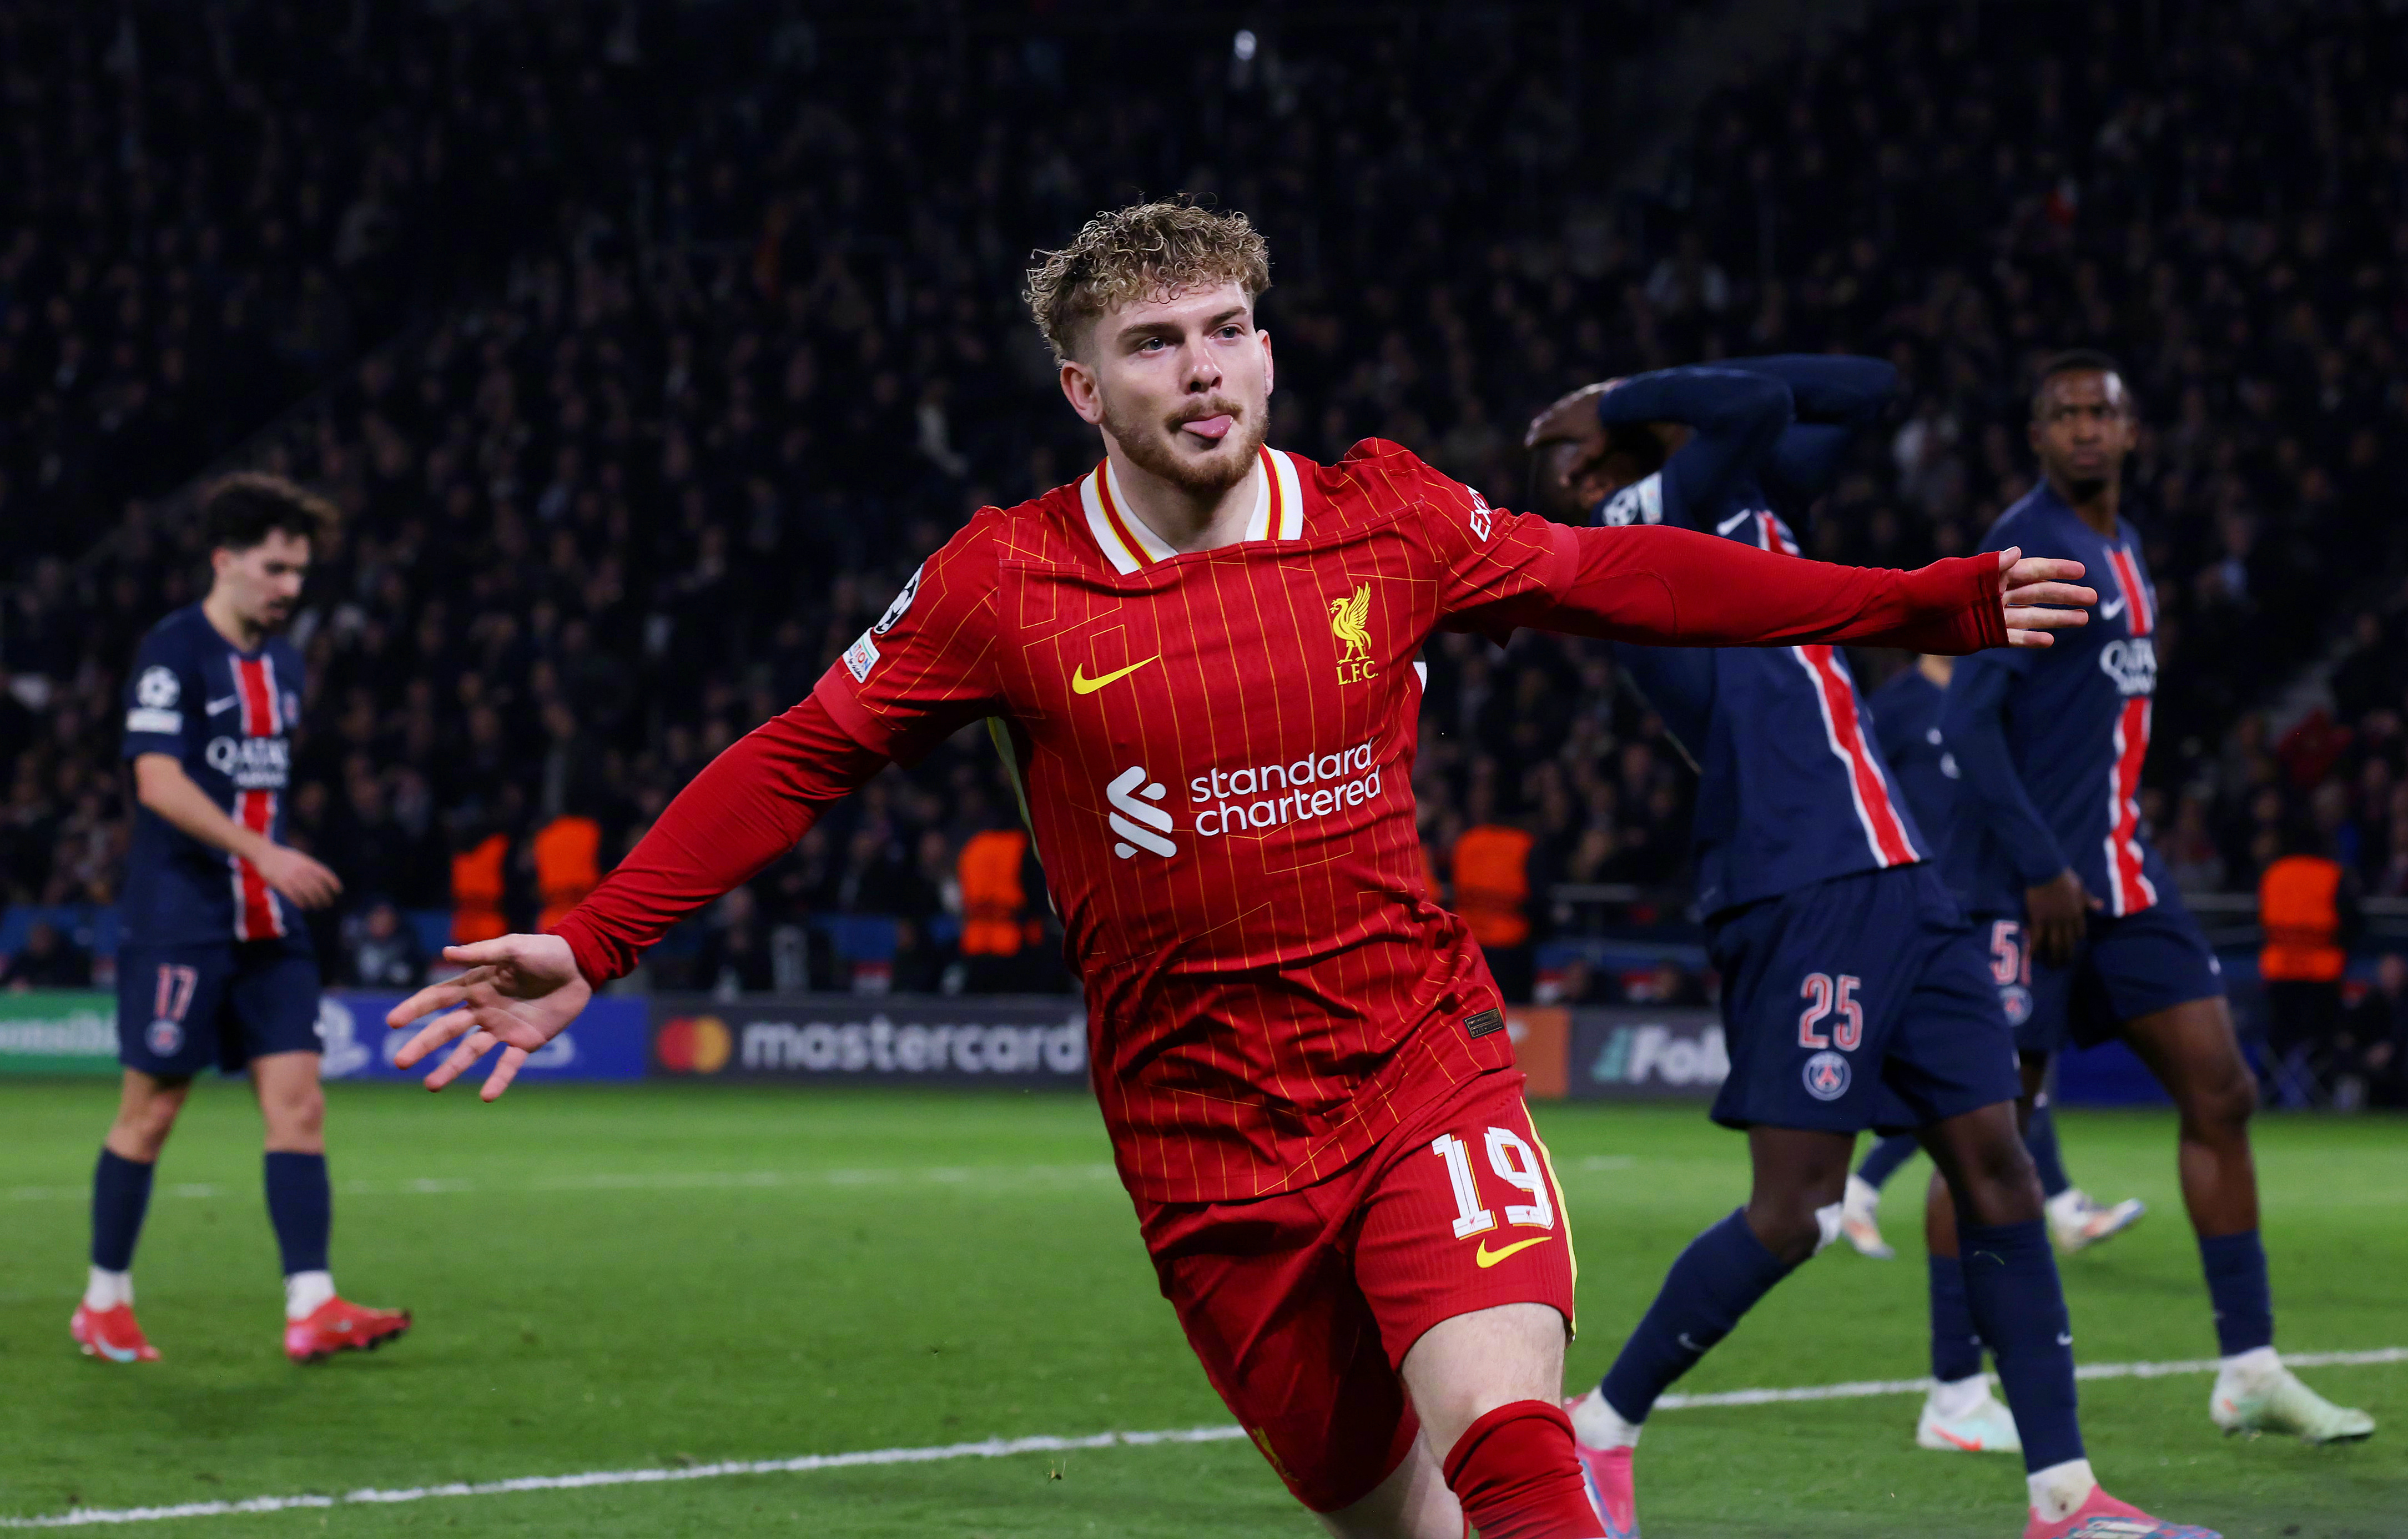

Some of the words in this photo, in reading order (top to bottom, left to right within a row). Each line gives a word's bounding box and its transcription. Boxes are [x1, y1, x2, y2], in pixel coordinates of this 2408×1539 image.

[1336, 661, 1379, 685] L.F.C.
[1191, 736, 1374, 803] standard
[1195, 765, 1381, 836] chartered
[155, 963, 199, 1023] 17
[1799, 973, 1863, 1052] 25
[742, 1013, 1086, 1074] mastercard
[1432, 1126, 1554, 1240] 19
